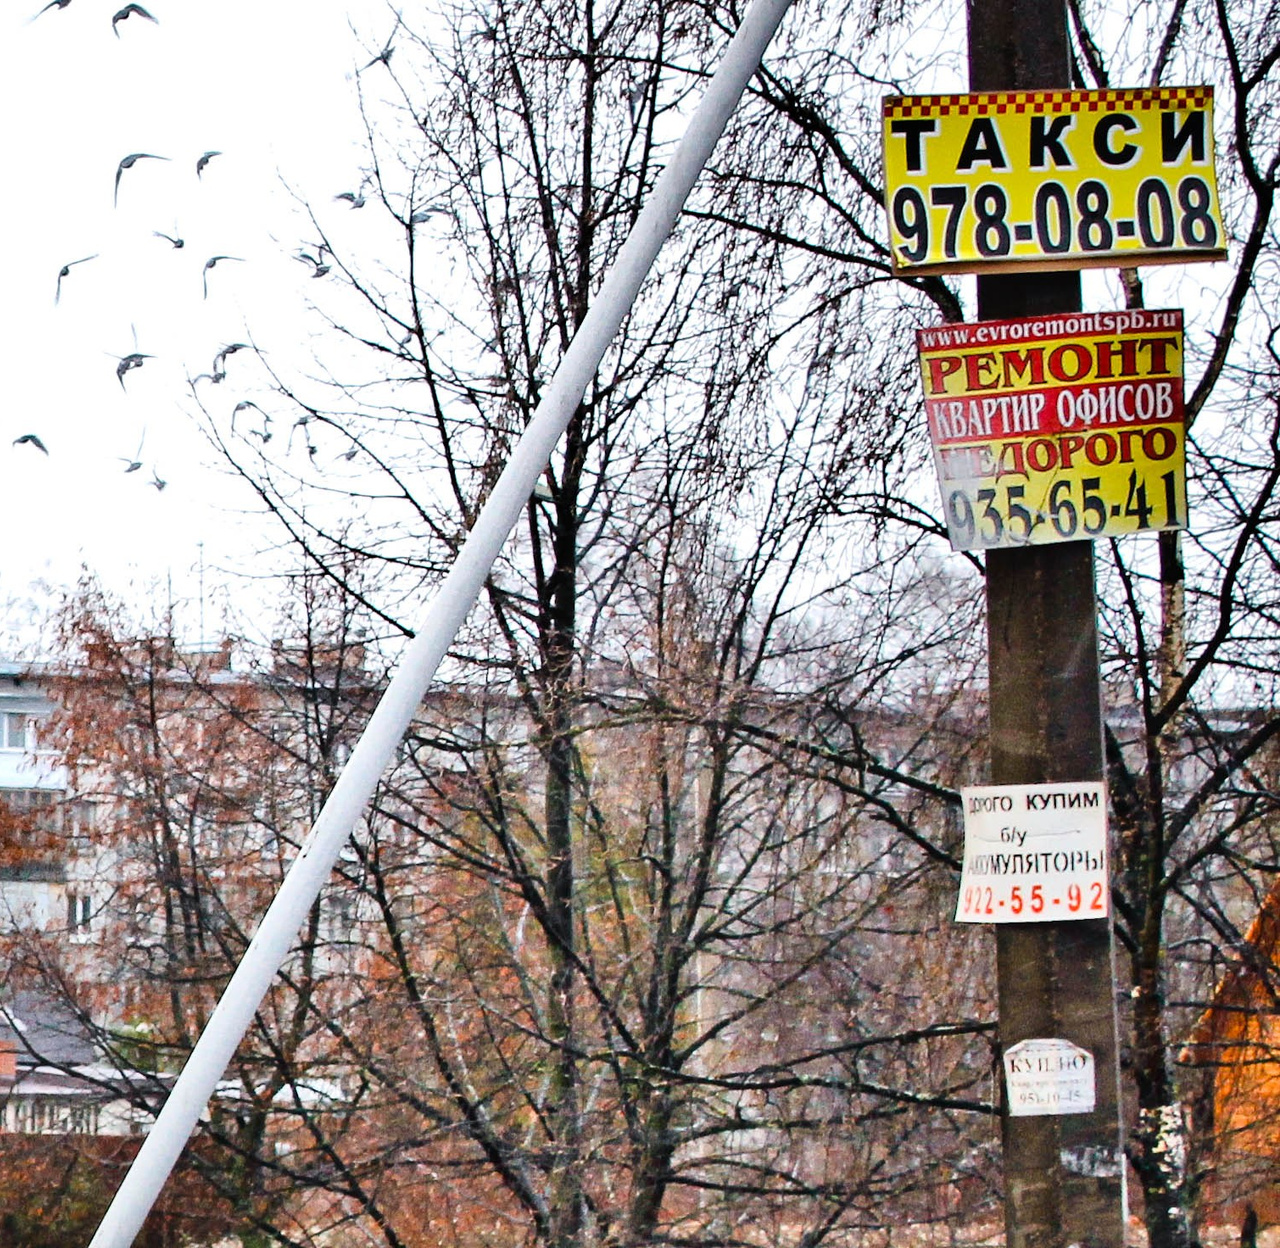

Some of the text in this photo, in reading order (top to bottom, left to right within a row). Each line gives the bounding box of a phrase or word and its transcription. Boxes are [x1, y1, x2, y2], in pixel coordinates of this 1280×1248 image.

[891, 111, 1207, 172] ТАКСИ
[892, 176, 1218, 262] 978-08-08
[922, 312, 1176, 348] www.evroremontspb.ru
[926, 337, 1179, 395] РЕМОНТ
[933, 382, 1174, 439] КВАРТИР ОФИСОВ
[948, 468, 1181, 545] 935-65-41
[1026, 792, 1099, 811] КУПИМ
[1000, 827, 1027, 847] б/у
[964, 882, 1103, 915] 922-55-92
